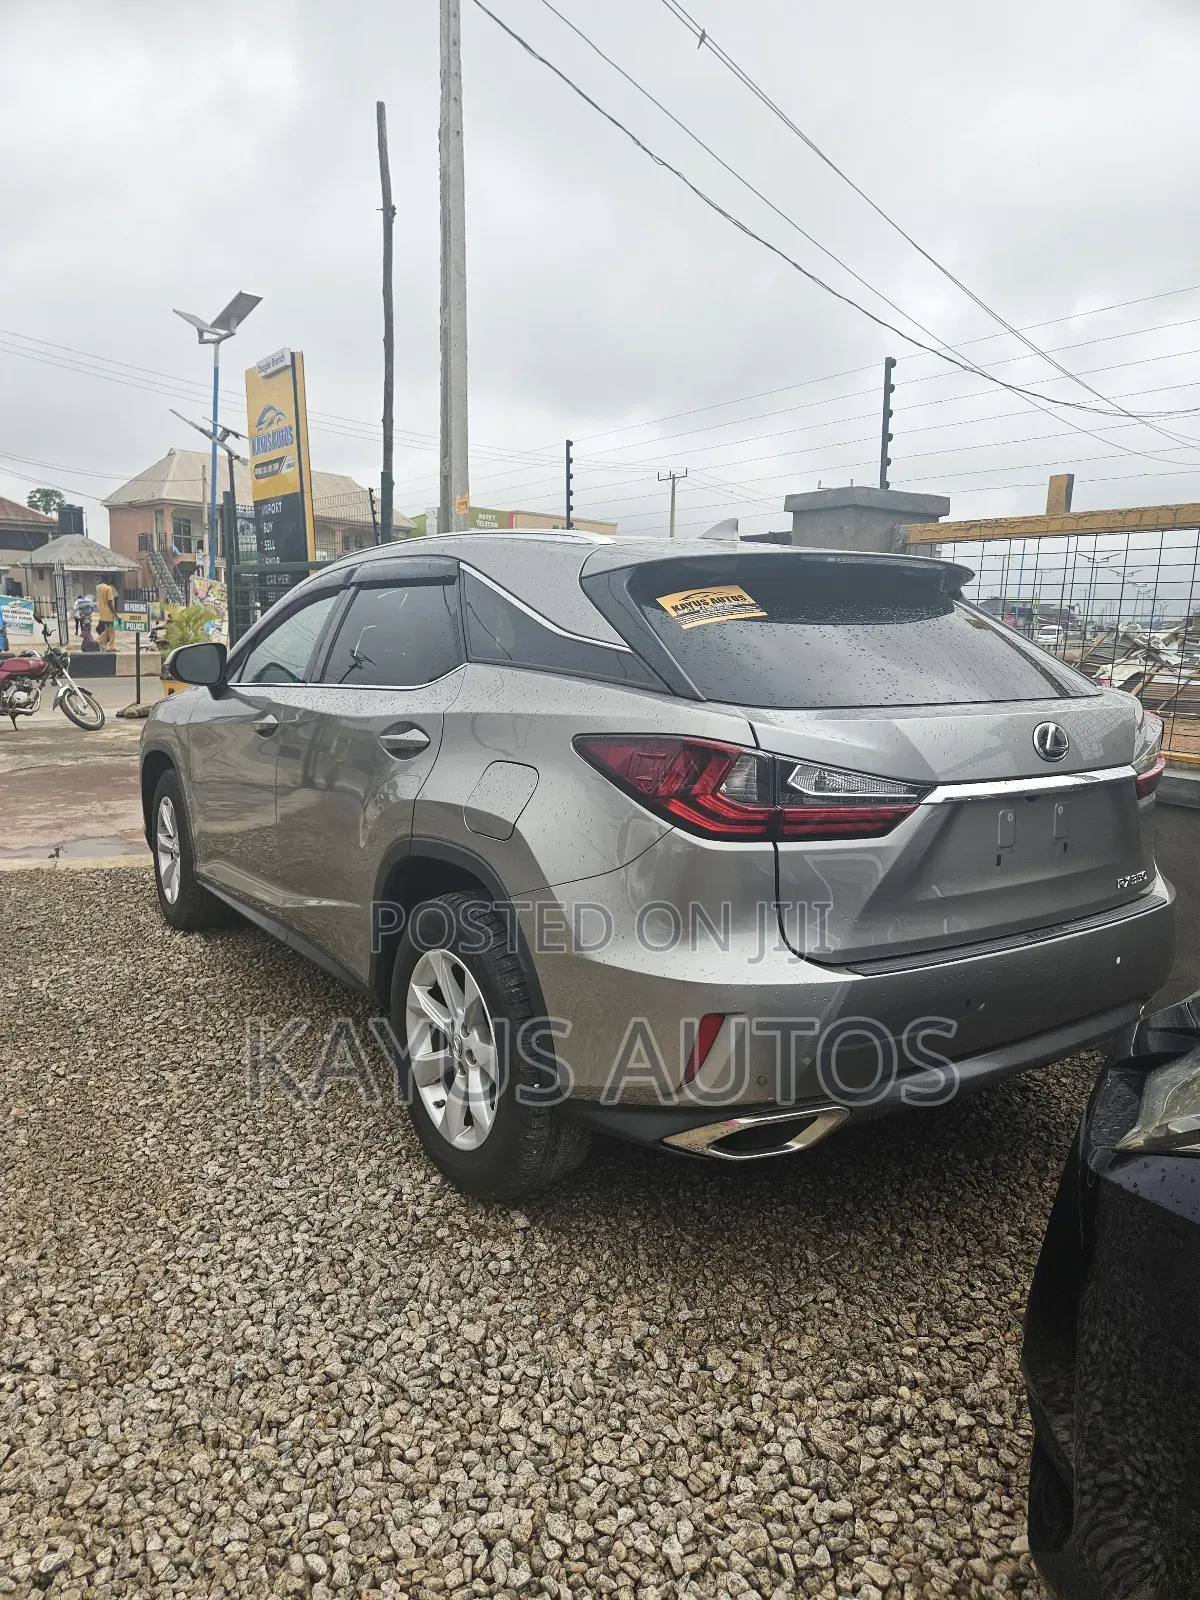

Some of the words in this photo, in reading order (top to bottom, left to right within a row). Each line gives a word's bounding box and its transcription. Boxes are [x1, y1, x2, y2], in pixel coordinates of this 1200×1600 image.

[272, 352, 285, 367] Branch
[252, 432, 271, 457] KAYUS
[272, 424, 293, 451] AUTOS
[261, 502, 282, 515] IMPORT
[263, 522, 273, 533] BUY
[476, 520, 498, 528] TELECOM
[264, 540, 275, 551] SELL
[130, 603, 146, 612] PARKING
[671, 599, 709, 614] KAYUS
[710, 594, 747, 605] AUTOS
[126, 622, 145, 631] POLICE
